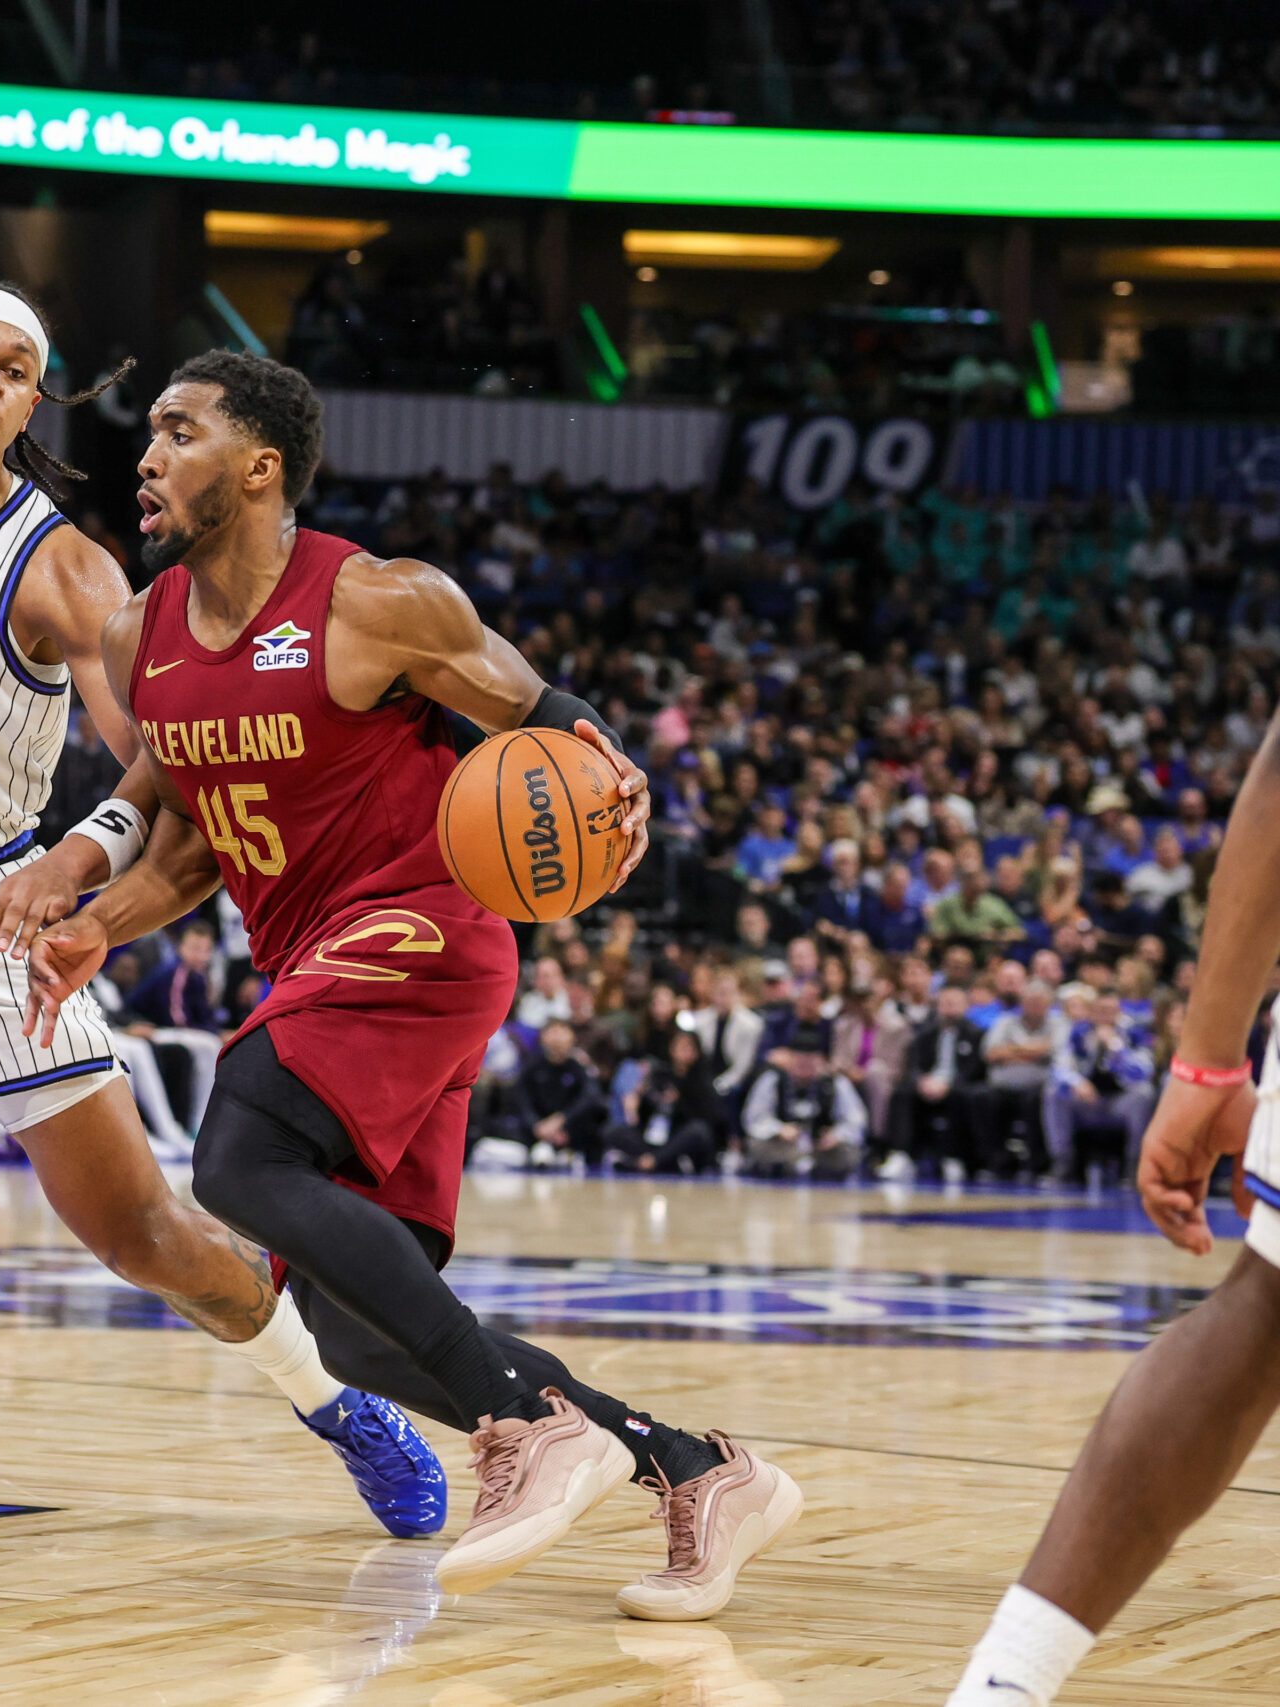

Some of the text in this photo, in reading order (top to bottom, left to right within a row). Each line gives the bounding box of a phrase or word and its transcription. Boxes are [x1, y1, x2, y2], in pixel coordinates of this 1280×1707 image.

[41, 108, 90, 152] of
[93, 111, 165, 158] the
[169, 117, 340, 169] Orlando
[345, 127, 471, 184] Magic
[255, 652, 307, 667] CLIFFS
[142, 713, 306, 767] CLEVELAND
[197, 783, 288, 877] 45
[522, 765, 568, 898] Wilson
